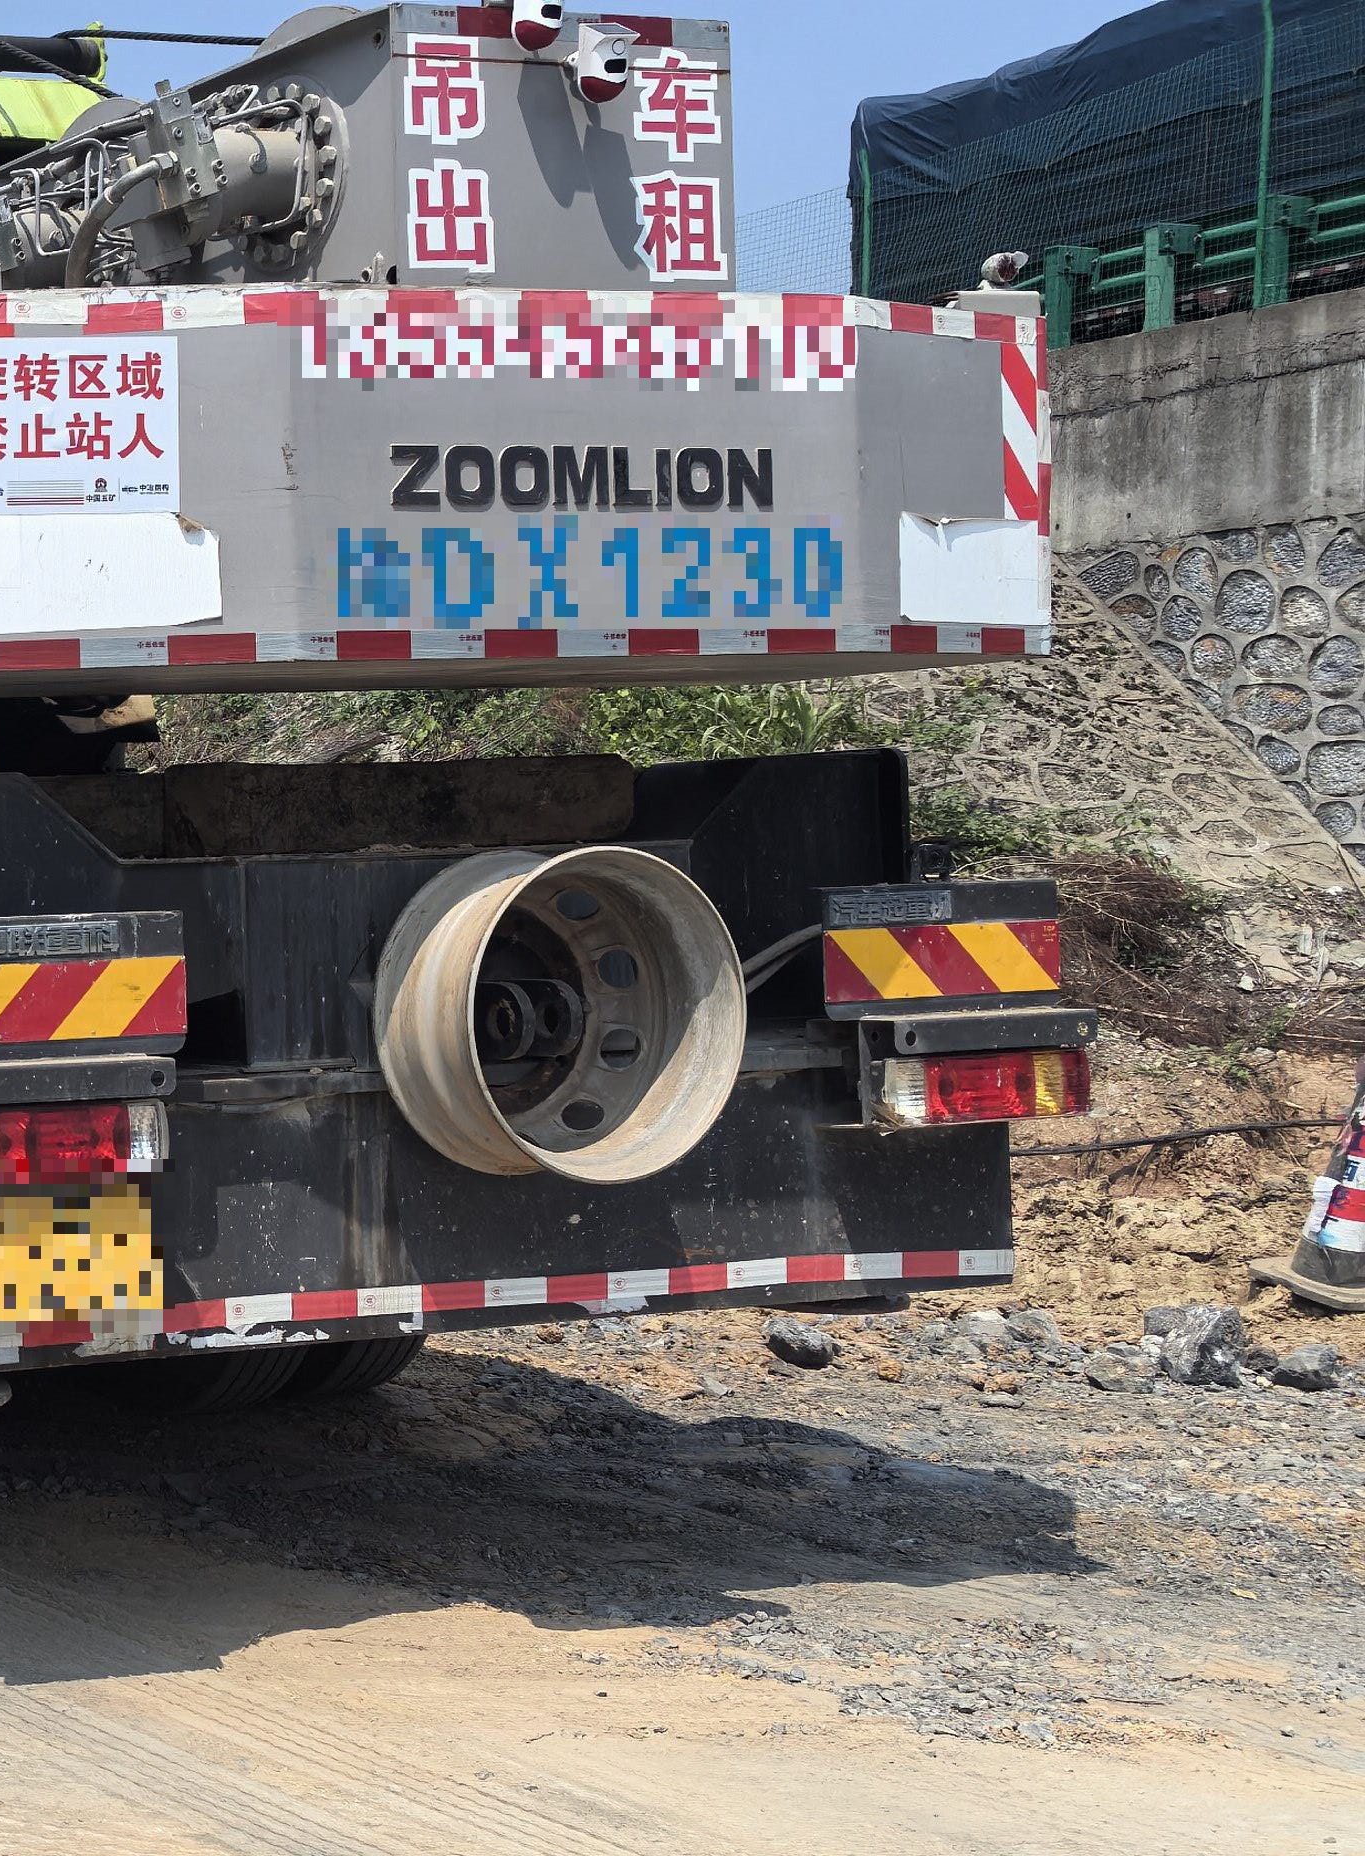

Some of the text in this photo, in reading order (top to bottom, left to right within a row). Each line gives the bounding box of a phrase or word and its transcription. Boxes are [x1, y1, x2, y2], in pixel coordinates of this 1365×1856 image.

[411, 42, 715, 154] 吊 车
[415, 169, 721, 273] 出 租
[389, 444, 774, 512] ZOOMLION
